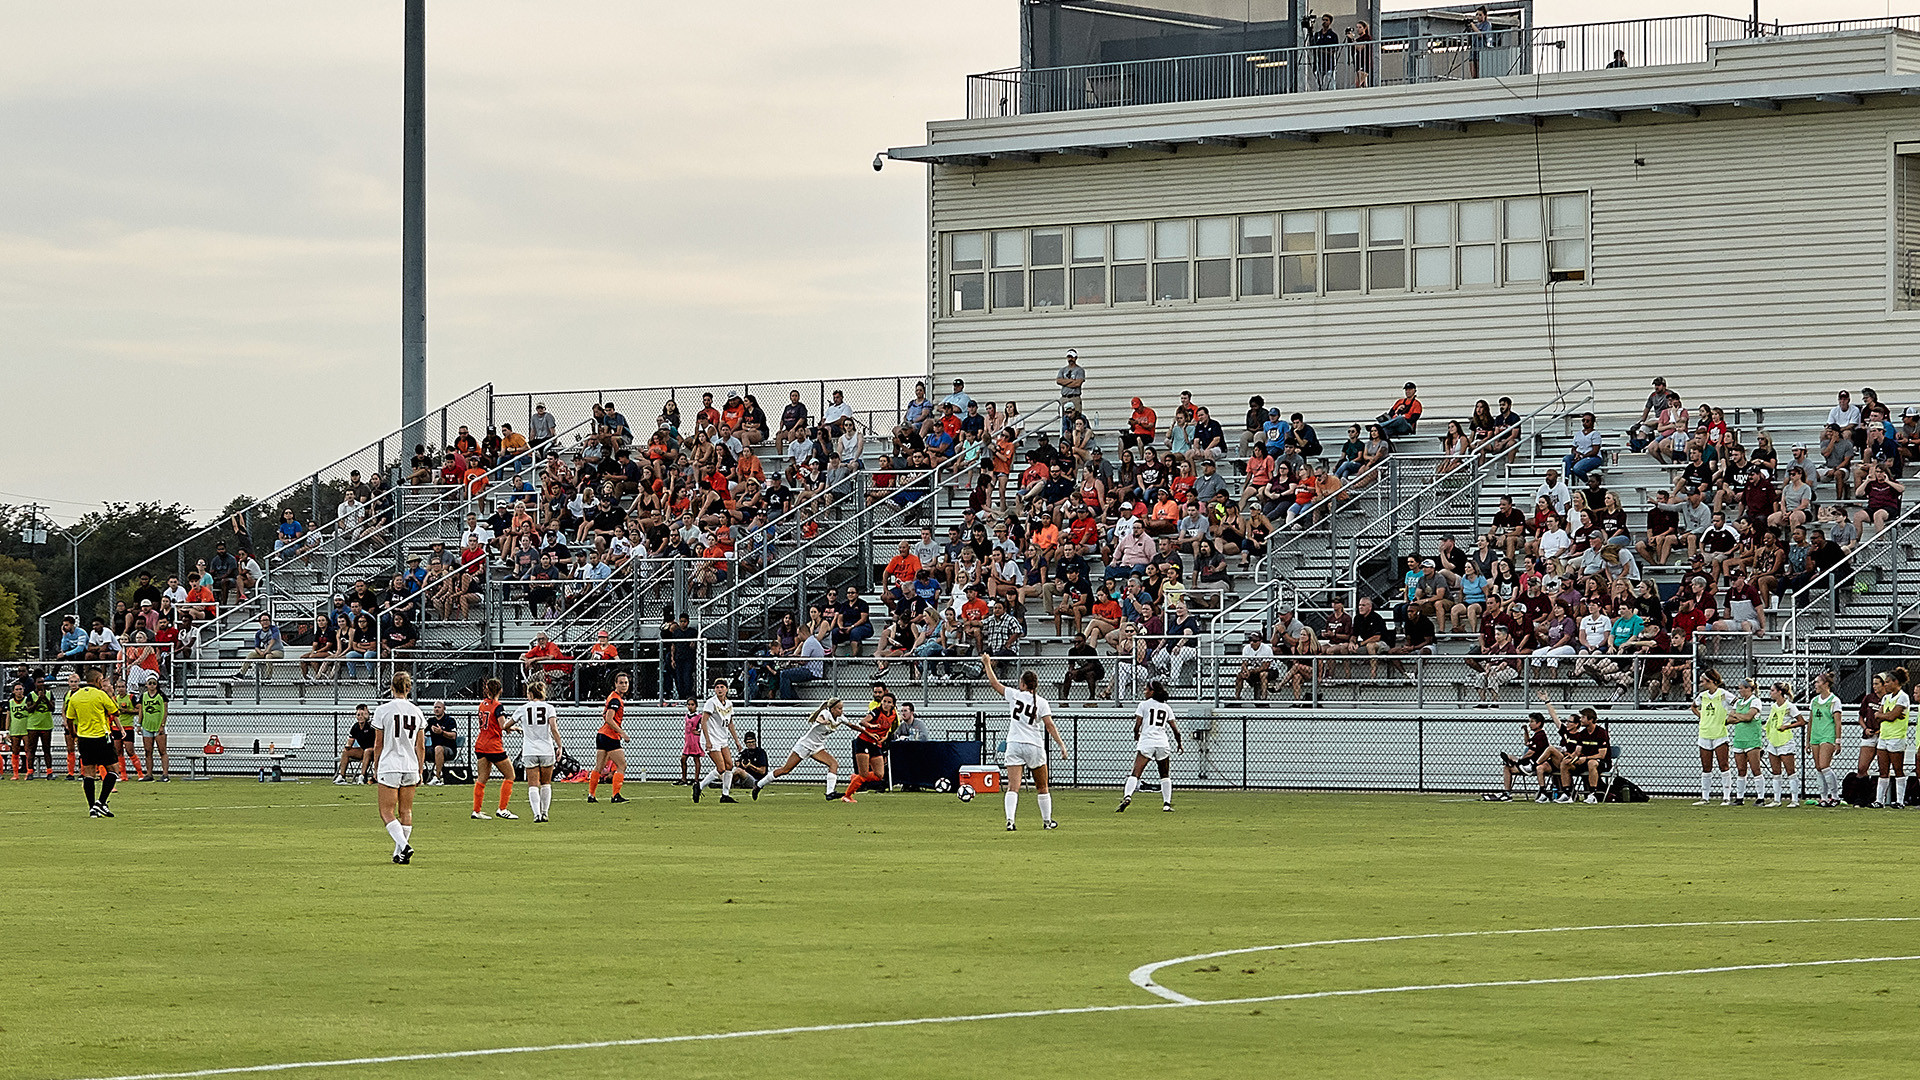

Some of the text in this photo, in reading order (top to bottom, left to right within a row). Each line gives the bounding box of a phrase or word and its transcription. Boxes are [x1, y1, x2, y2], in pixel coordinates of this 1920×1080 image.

[526, 706, 547, 725] 13
[1012, 700, 1037, 725] 24
[1149, 708, 1166, 727] 19
[394, 714, 416, 739] 14
[983, 774, 993, 787] G
